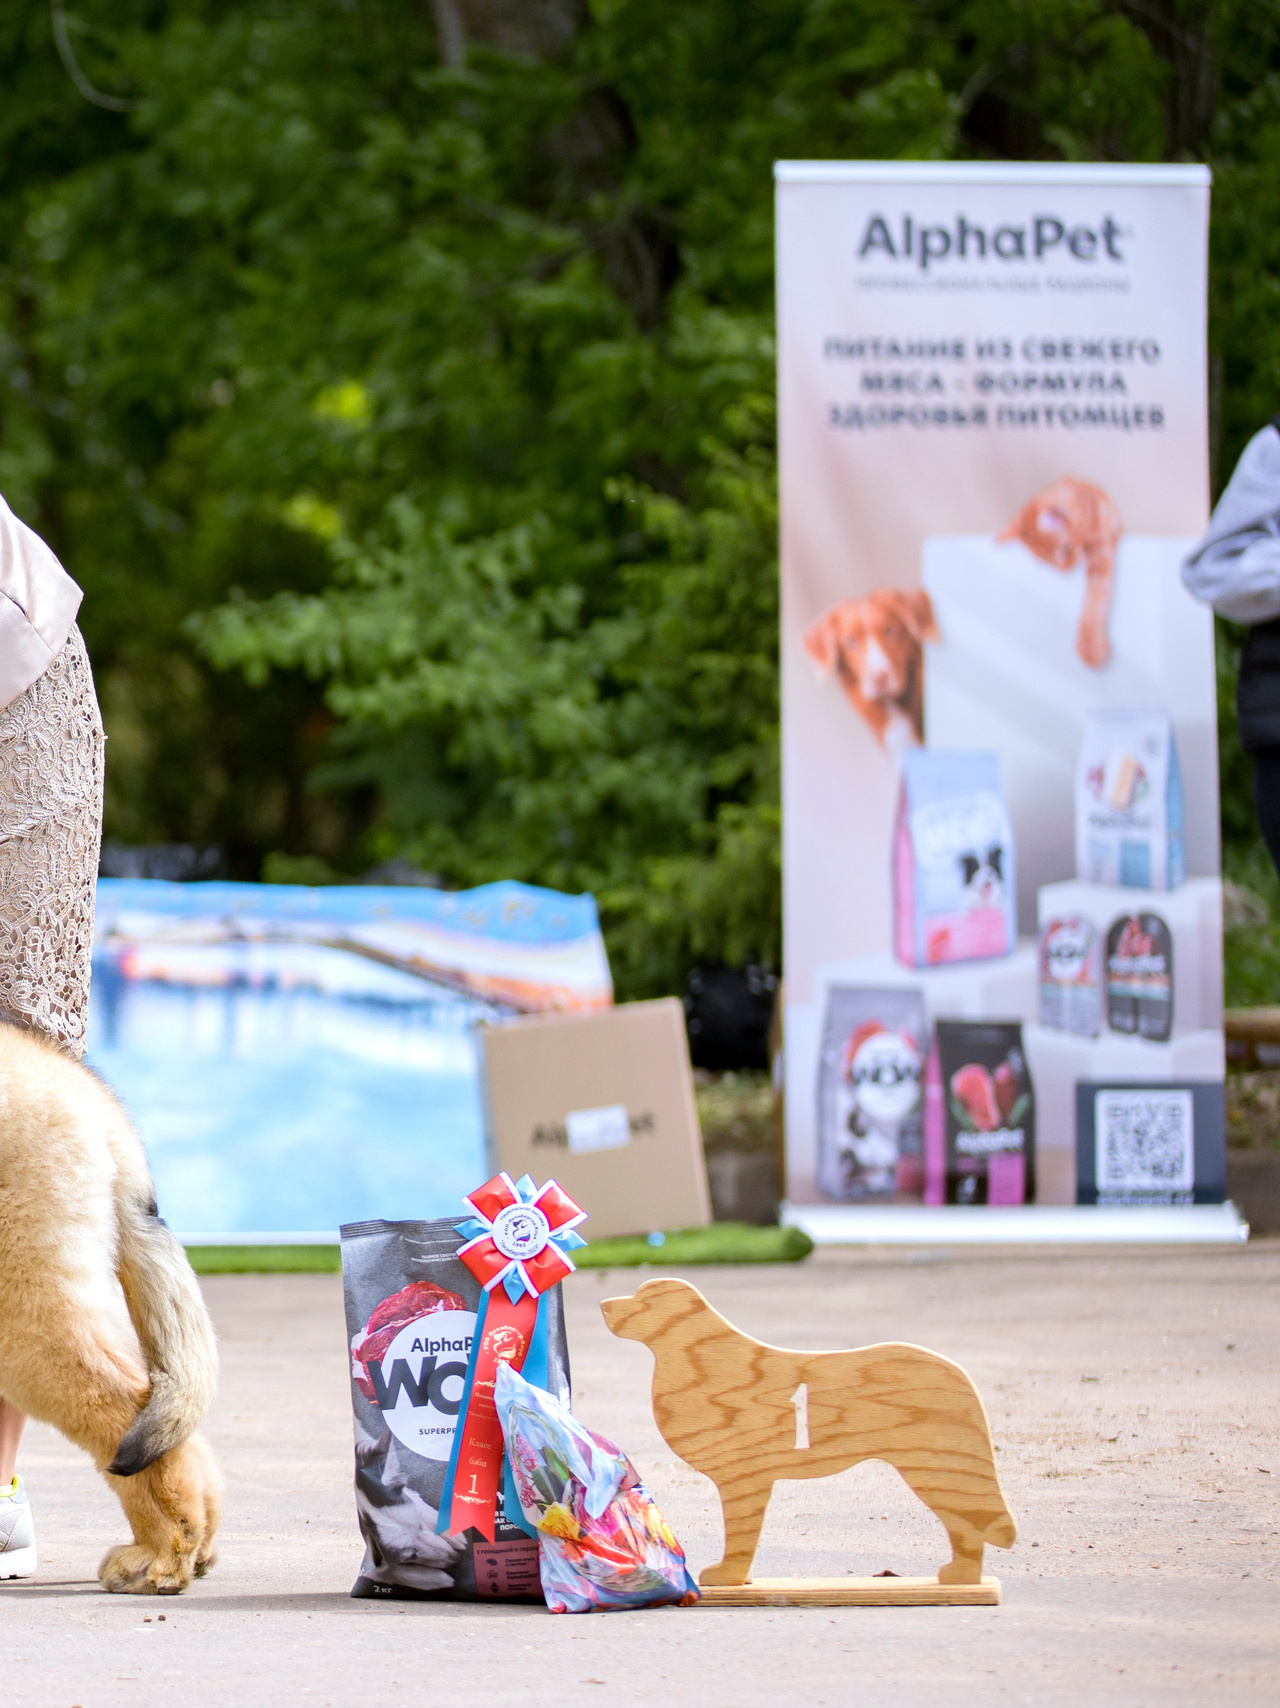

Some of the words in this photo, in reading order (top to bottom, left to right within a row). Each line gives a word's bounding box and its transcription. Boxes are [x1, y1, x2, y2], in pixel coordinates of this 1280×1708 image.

[858, 213, 1124, 270] AlphaPet
[824, 336, 967, 360] ПИТАНИЕ
[976, 336, 1013, 360] ИЗ
[1022, 336, 1161, 361] СВЕЖЕГО
[861, 371, 945, 393] МЯСА
[974, 370, 1127, 394] ФОРМУЛА
[829, 404, 988, 430] ЗДОРОВЬЯ
[996, 404, 1164, 432] ПИТОМЦЕВ
[365, 1353, 471, 1416] WO
[789, 1382, 811, 1449] 1
[468, 1437, 492, 1450] Класс
[467, 1474, 479, 1495] 1
